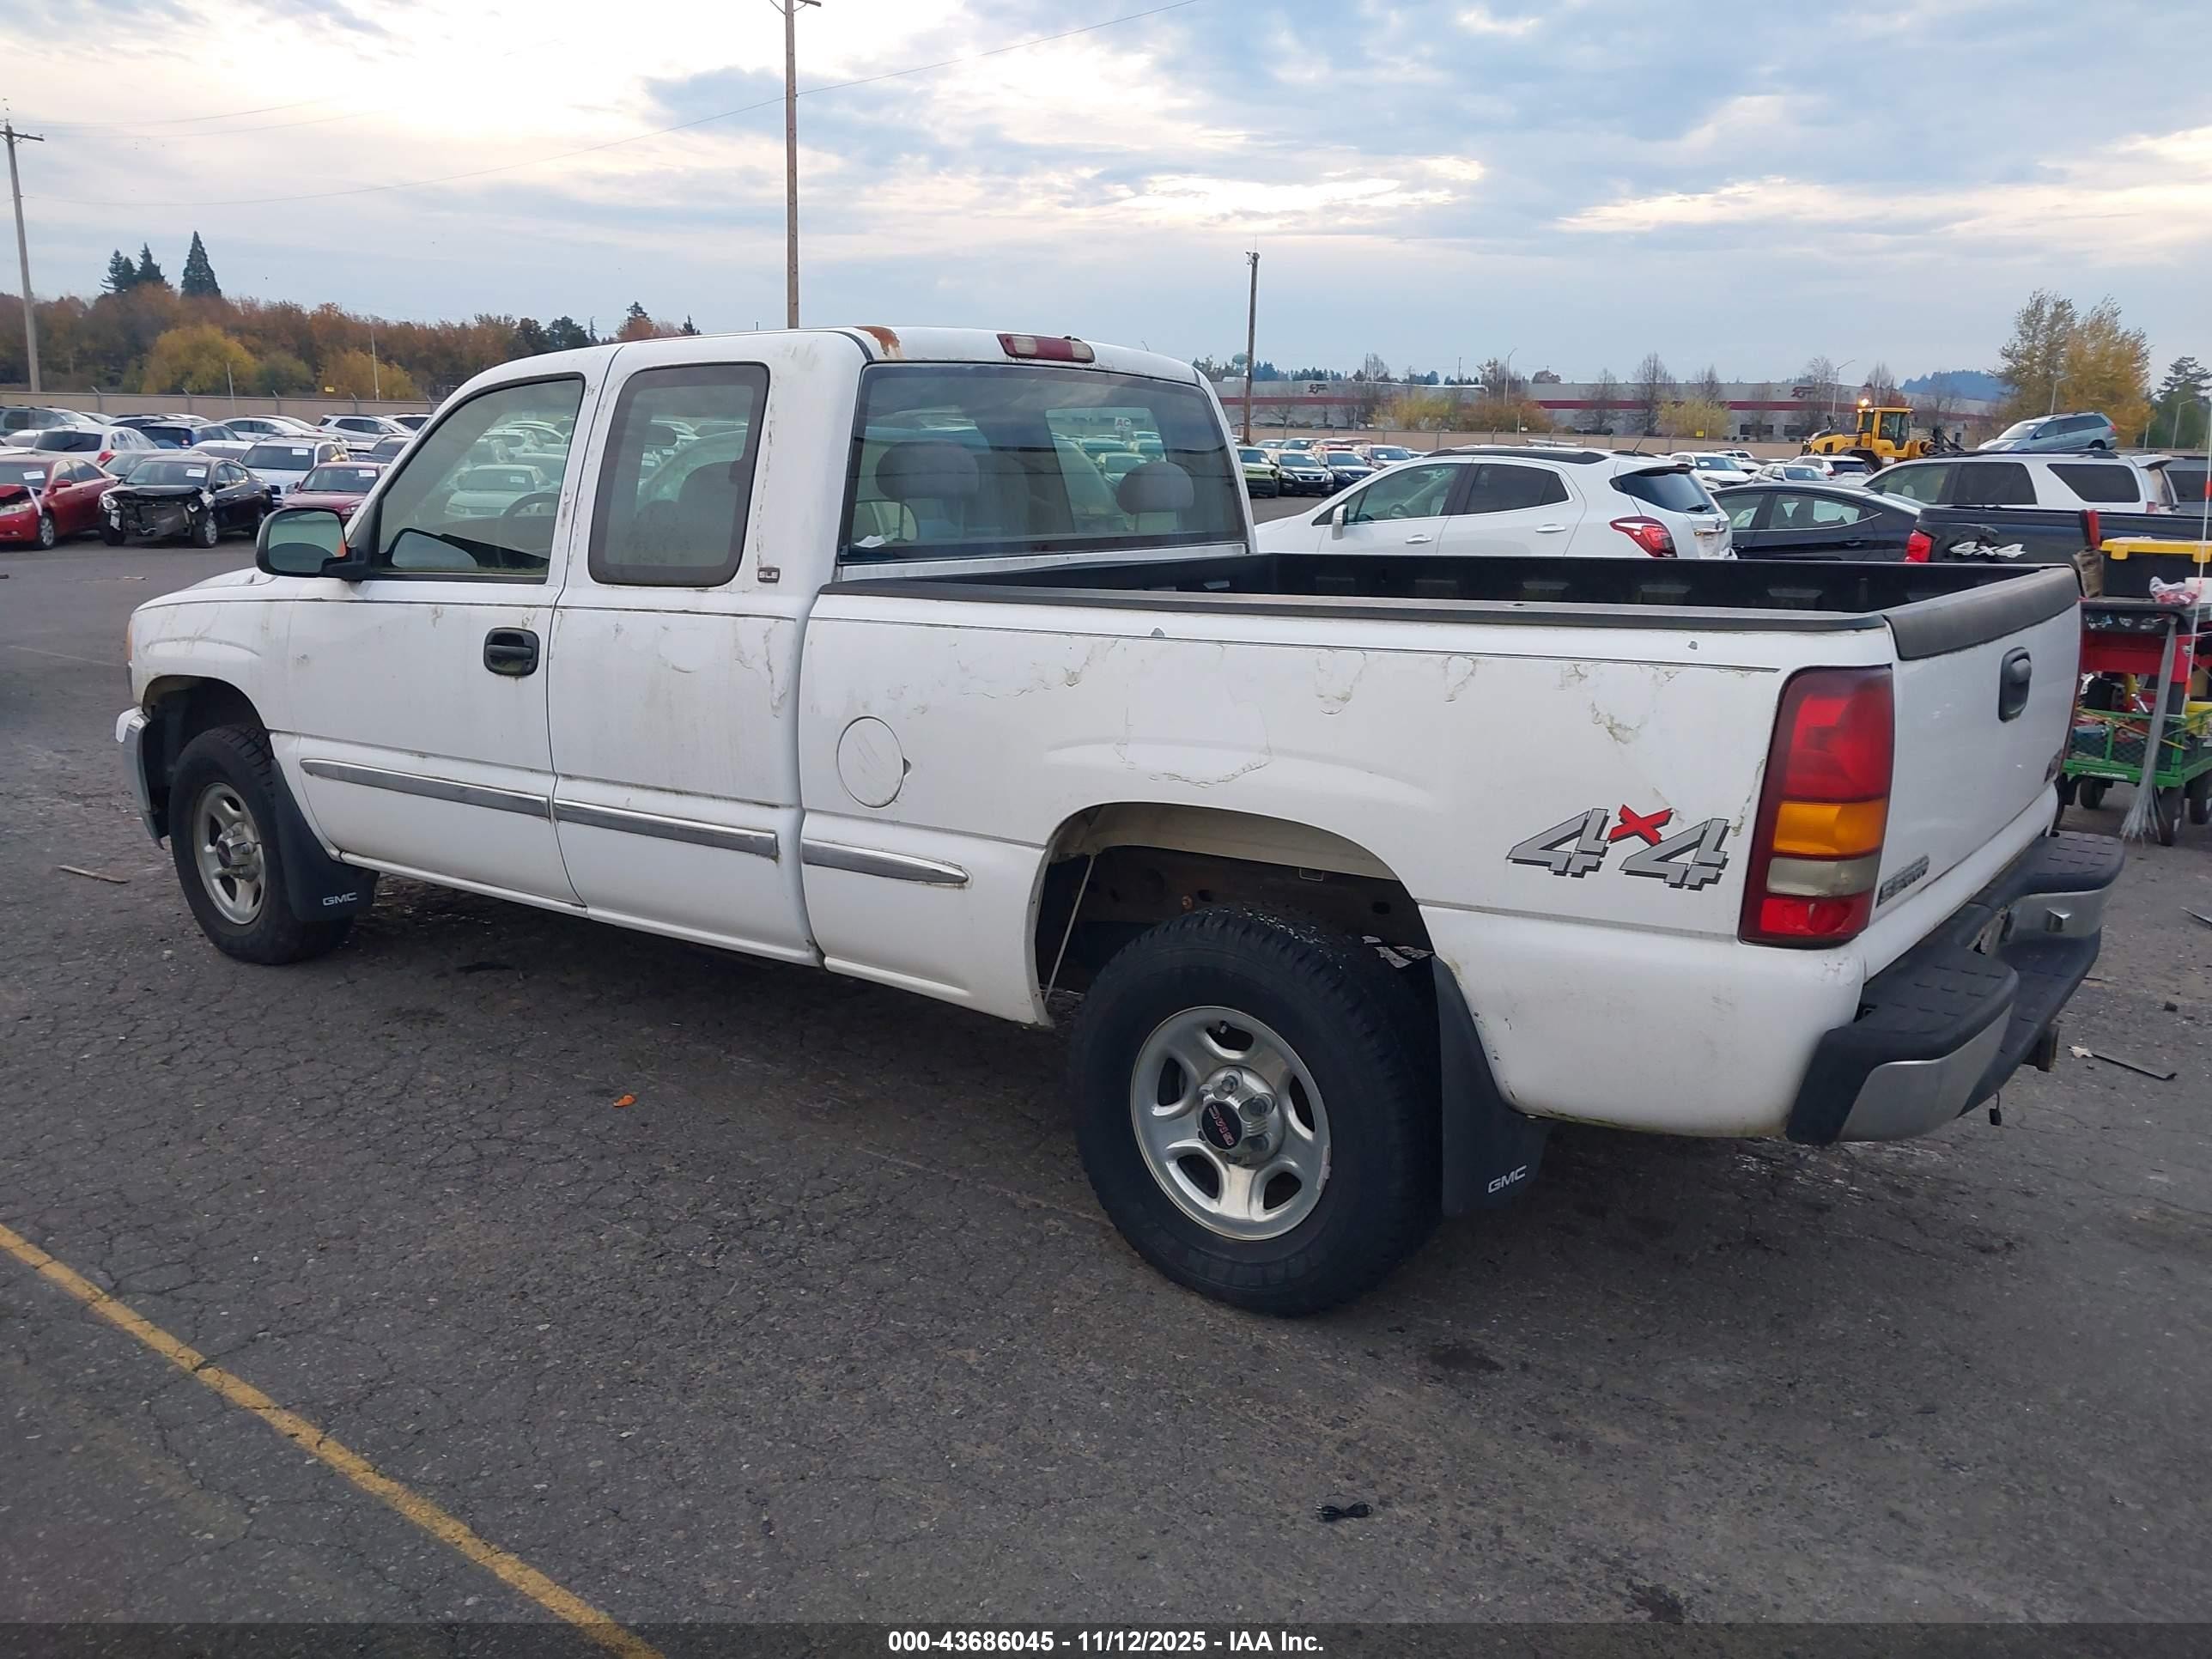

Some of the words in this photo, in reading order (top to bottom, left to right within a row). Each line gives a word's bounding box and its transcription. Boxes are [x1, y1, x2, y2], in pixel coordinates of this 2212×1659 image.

[322, 891, 358, 906] GMC
[1208, 1104, 1236, 1146] GMC
[1487, 1164, 1528, 1194] GMC
